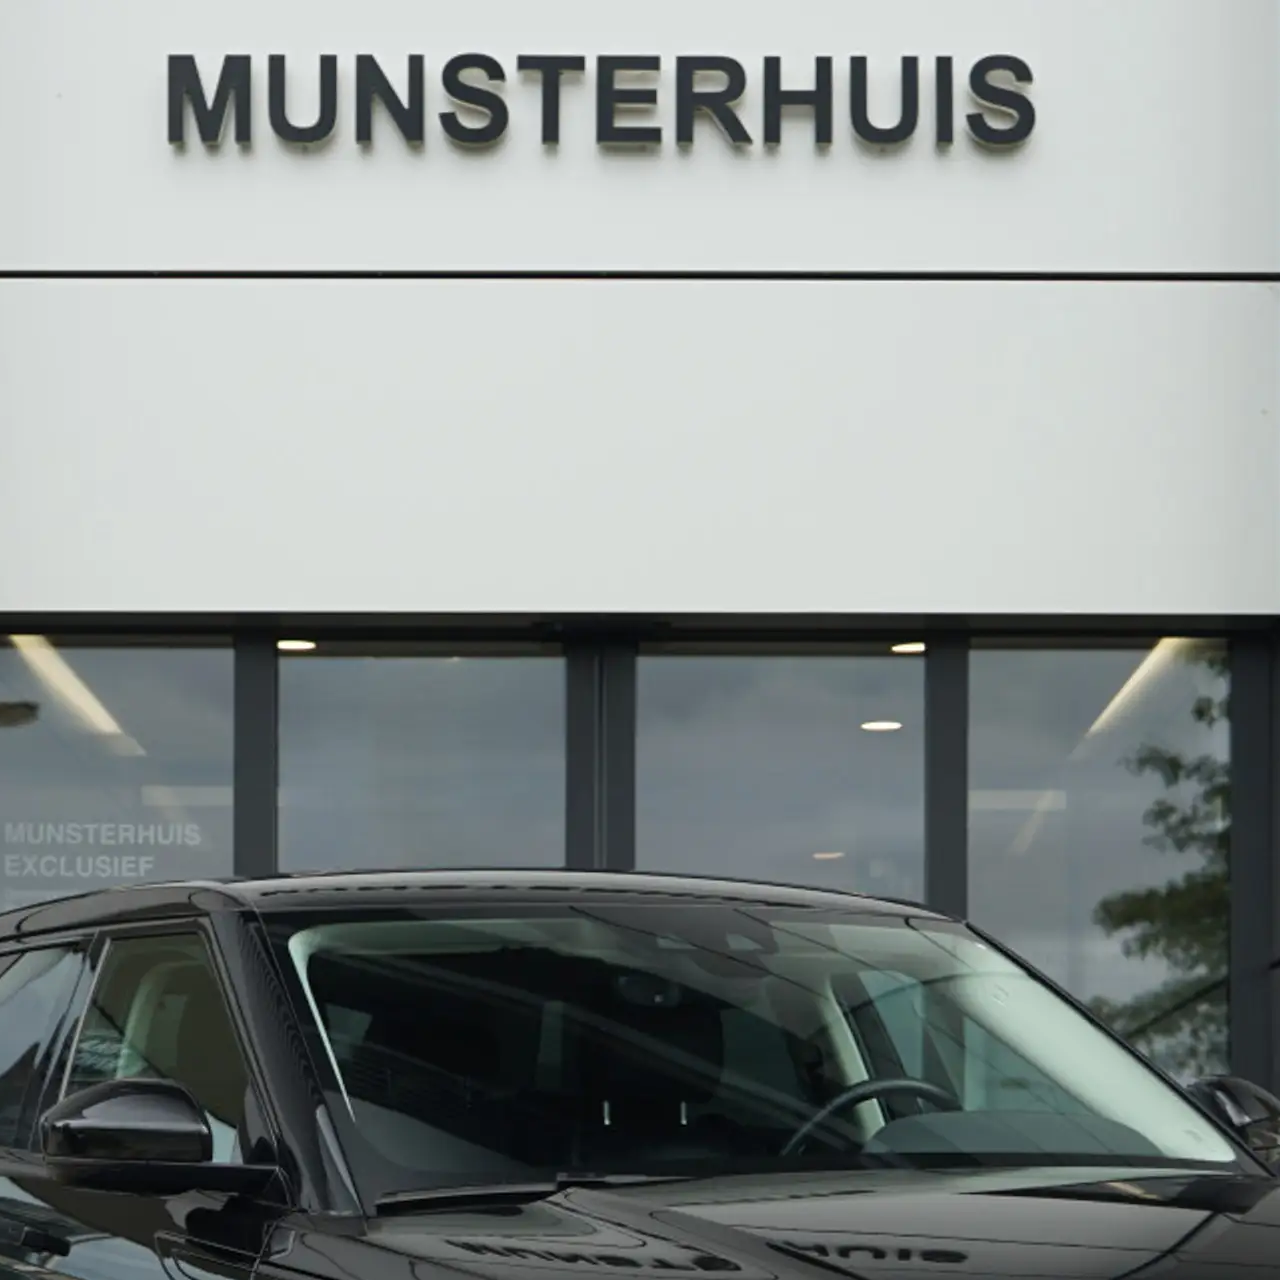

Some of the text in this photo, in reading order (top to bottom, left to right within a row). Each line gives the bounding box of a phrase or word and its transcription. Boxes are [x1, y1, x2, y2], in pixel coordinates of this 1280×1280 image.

[167, 53, 1037, 148] MUNSTERHUIS
[4, 822, 202, 846] MUNSTERHUIS
[4, 854, 155, 878] EXCLUSIEF
